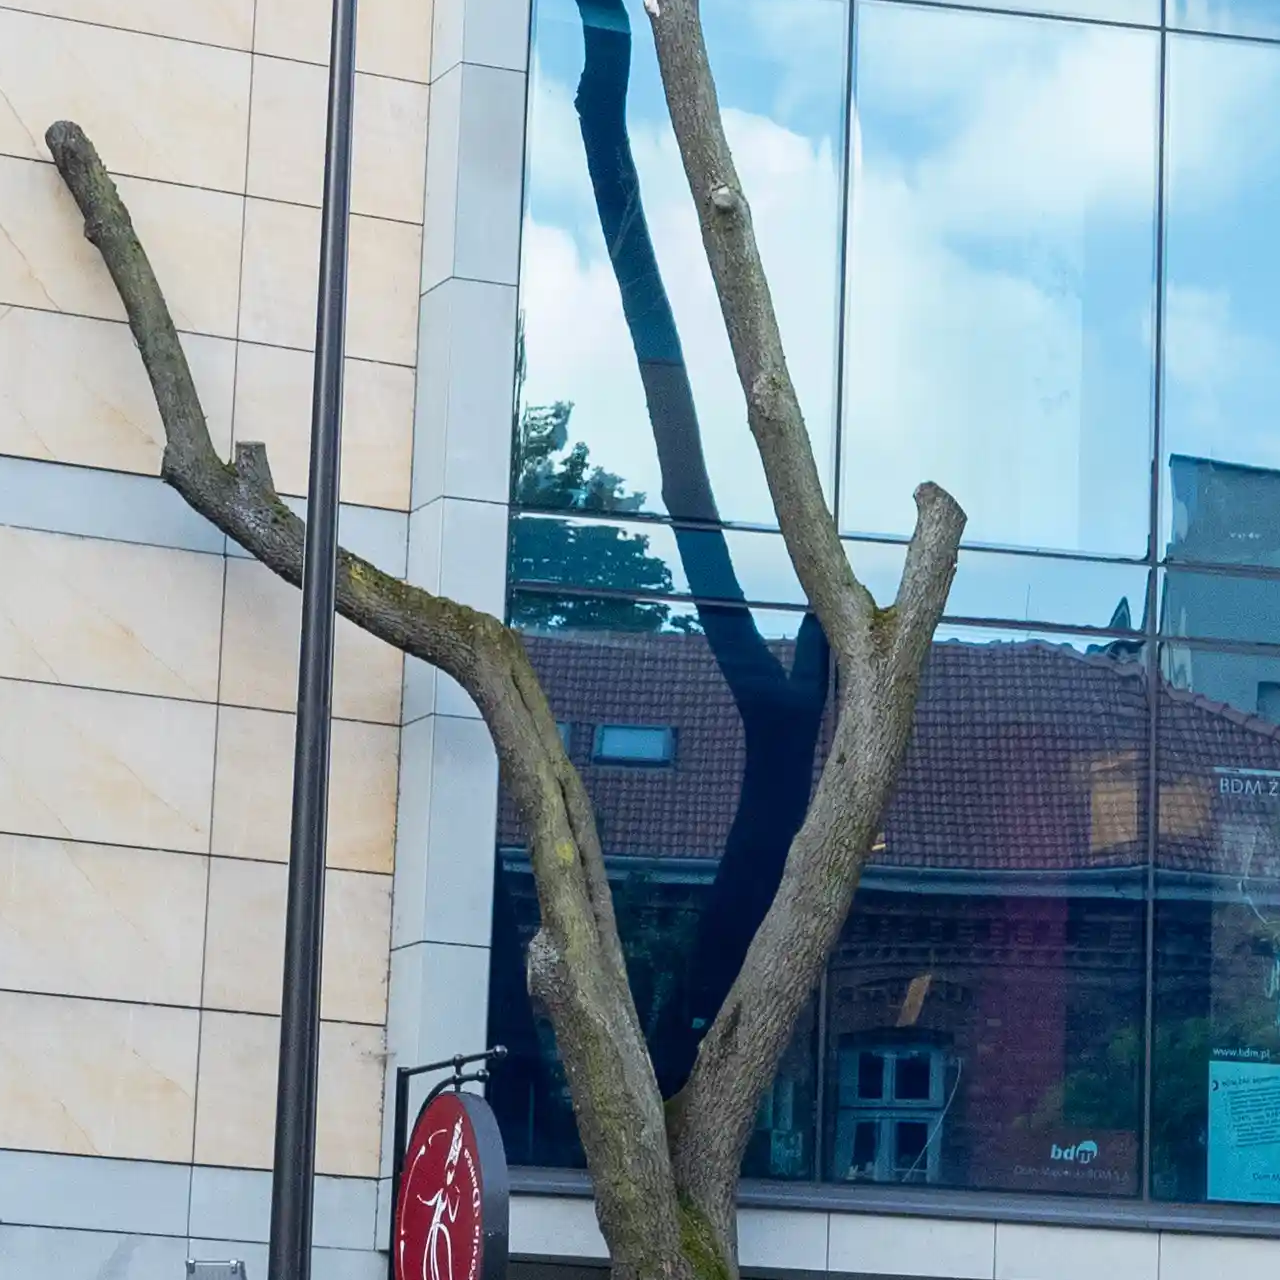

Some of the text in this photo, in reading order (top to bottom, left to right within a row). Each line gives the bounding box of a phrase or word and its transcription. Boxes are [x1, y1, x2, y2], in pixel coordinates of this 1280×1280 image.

[1220, 777, 1261, 795] BDM
[1212, 1048, 1270, 1059] www.bdm.pl
[1050, 1140, 1098, 1163] bdm
